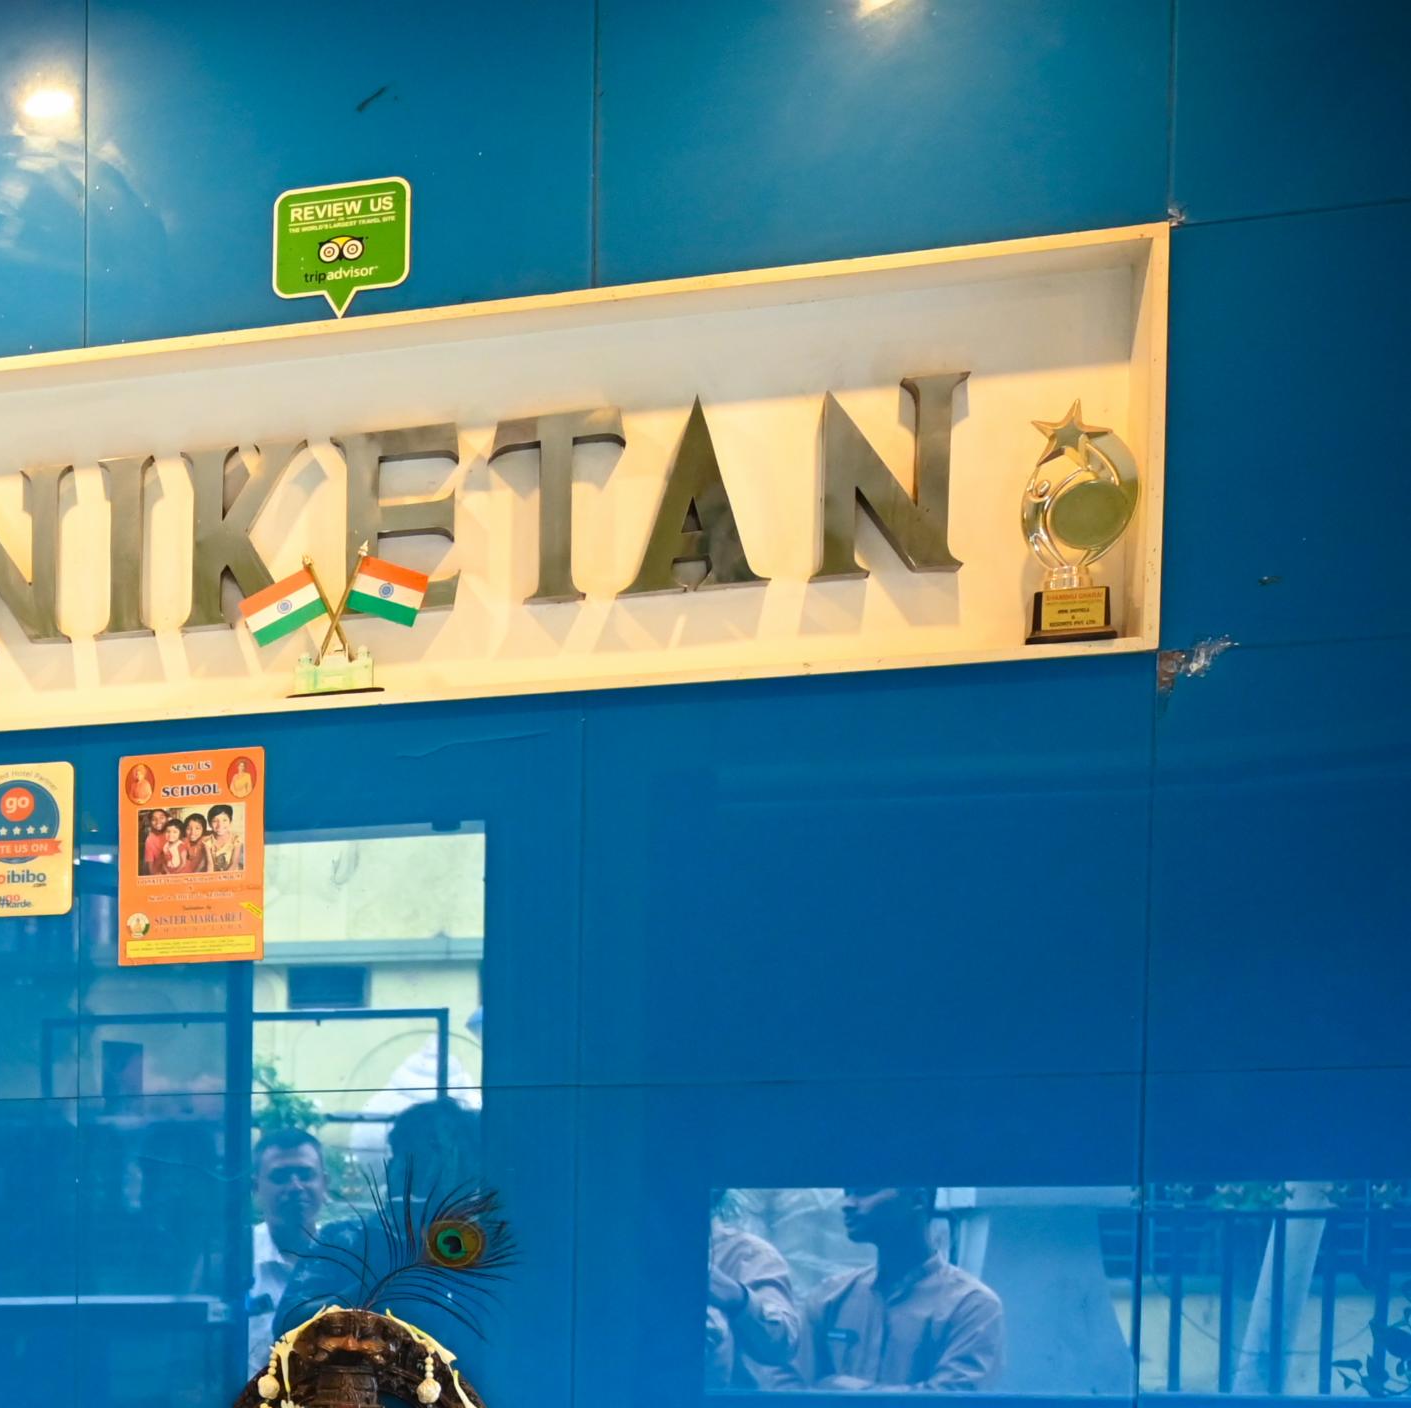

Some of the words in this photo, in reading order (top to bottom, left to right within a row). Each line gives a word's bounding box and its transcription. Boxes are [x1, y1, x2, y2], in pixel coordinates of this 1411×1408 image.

[290, 200, 362, 222] REVIEW
[369, 195, 394, 212] US
[304, 266, 375, 284] tripadvisor
[170, 763, 194, 773] SEND
[197, 760, 212, 770] US
[161, 783, 221, 798] SCHOOL
[5, 796, 30, 814] go
[15, 844, 29, 853] US
[31, 843, 49, 852] ON
[154, 915, 186, 926] SISTER
[189, 911, 243, 924] MARGARET
